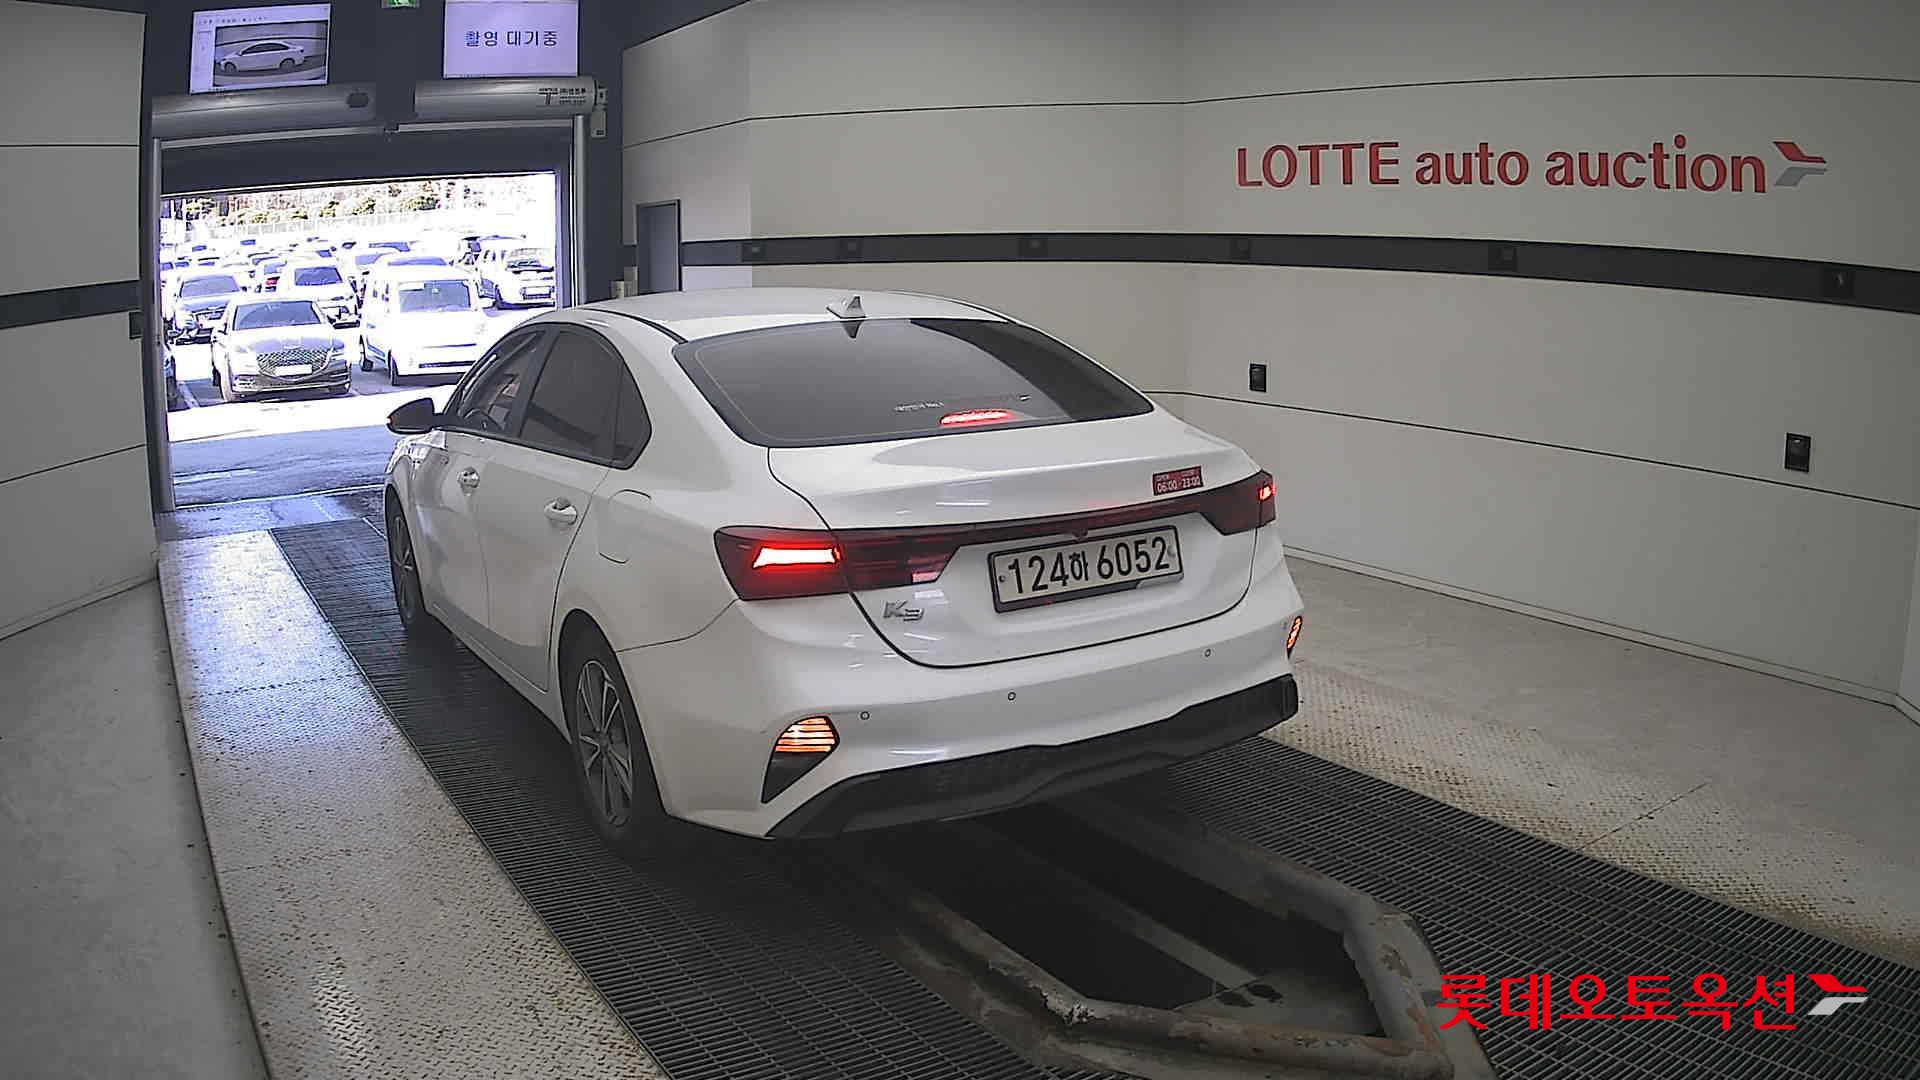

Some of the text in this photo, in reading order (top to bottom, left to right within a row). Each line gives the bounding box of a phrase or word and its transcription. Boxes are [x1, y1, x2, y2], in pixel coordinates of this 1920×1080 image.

[466, 30, 558, 47] 촬영 대기중
[1237, 134, 1766, 193] LOTTE auto auction
[1008, 536, 1170, 594] 124하 6052
[882, 601, 925, 622] K3
